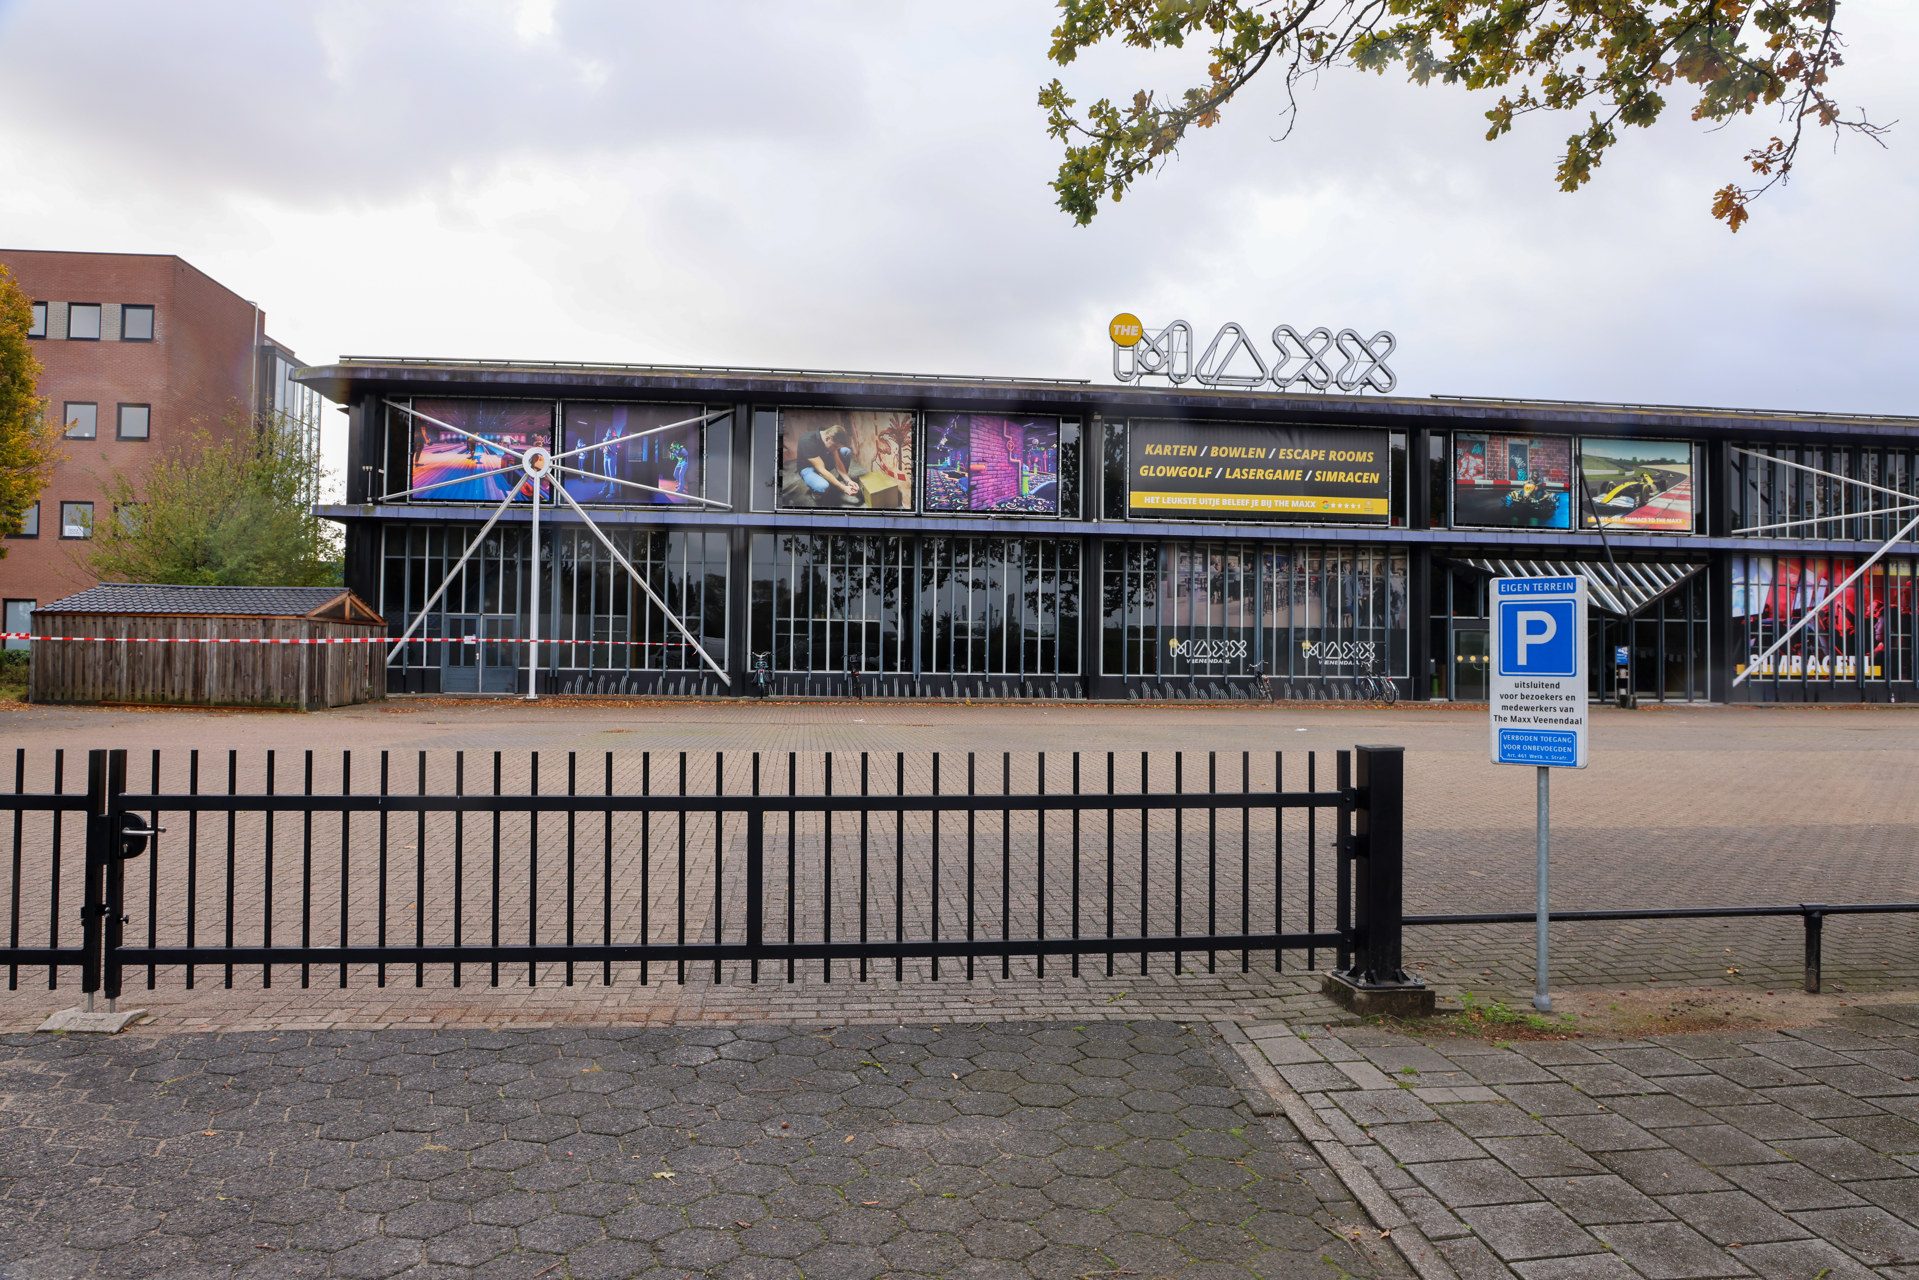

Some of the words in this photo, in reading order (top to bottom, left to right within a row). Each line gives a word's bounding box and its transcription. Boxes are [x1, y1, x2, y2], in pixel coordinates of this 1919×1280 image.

[1113, 324, 1139, 336] THE
[1113, 320, 1397, 393] MAXX
[1144, 444, 1198, 456] KARTEN
[1200, 446, 1208, 456] /
[1210, 446, 1266, 459] BOWLEN
[1268, 448, 1276, 459] /
[1278, 448, 1326, 460] ESCAPE
[1328, 450, 1374, 462] ROOMS
[1140, 465, 1213, 478] GLOWGOLF
[1214, 468, 1223, 478] /
[1225, 468, 1303, 480] LASERGAME
[1304, 470, 1312, 481] /
[1314, 470, 1380, 484] SIMRACEN
[1144, 496, 1160, 504] HET
[1162, 496, 1197, 505] LEUKSTE
[1199, 498, 1220, 507] UITJE
[1222, 498, 1250, 507] BELEEF
[1251, 499, 1258, 508] JE
[1261, 499, 1272, 508] BIJ
[1274, 500, 1290, 508] THE
[1292, 500, 1316, 508] MAXX
[1501, 583, 1530, 592] EIGEN
[1532, 582, 1574, 591] TERREIN
[1517, 610, 1557, 665] P
[1515, 681, 1560, 689] uitsluitend
[1520, 692, 1563, 701] bezoekers
[1501, 704, 1557, 713] medewerkers
[1494, 714, 1508, 723] The
[1533, 716, 1582, 725] Veenendaal
